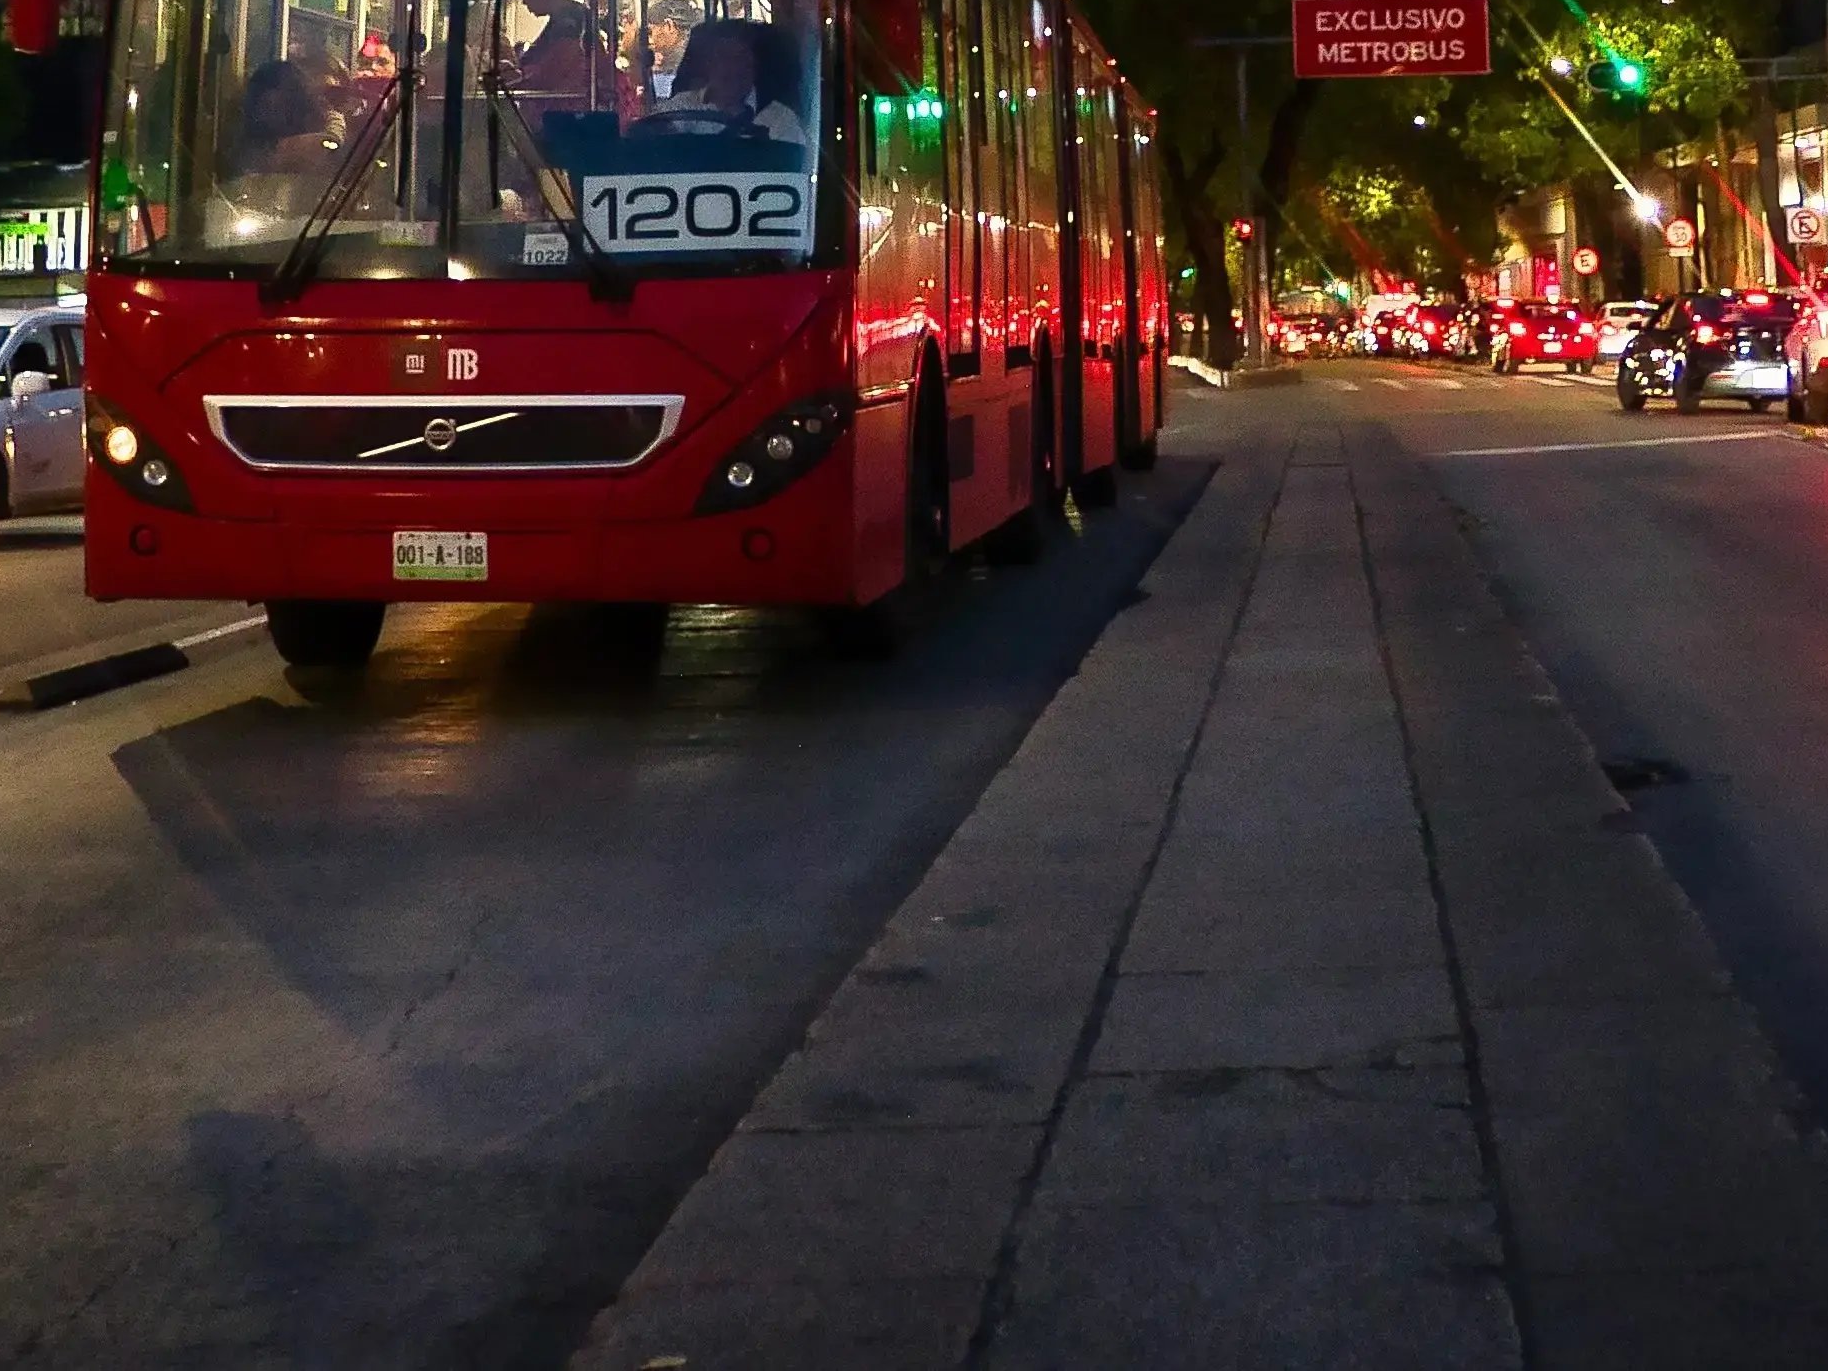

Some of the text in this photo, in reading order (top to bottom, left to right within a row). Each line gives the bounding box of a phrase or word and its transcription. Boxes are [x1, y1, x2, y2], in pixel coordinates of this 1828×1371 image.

[1315, 7, 1465, 32] EXCLUSIVO
[1317, 38, 1466, 64] METROBUS
[589, 184, 801, 241] 1202
